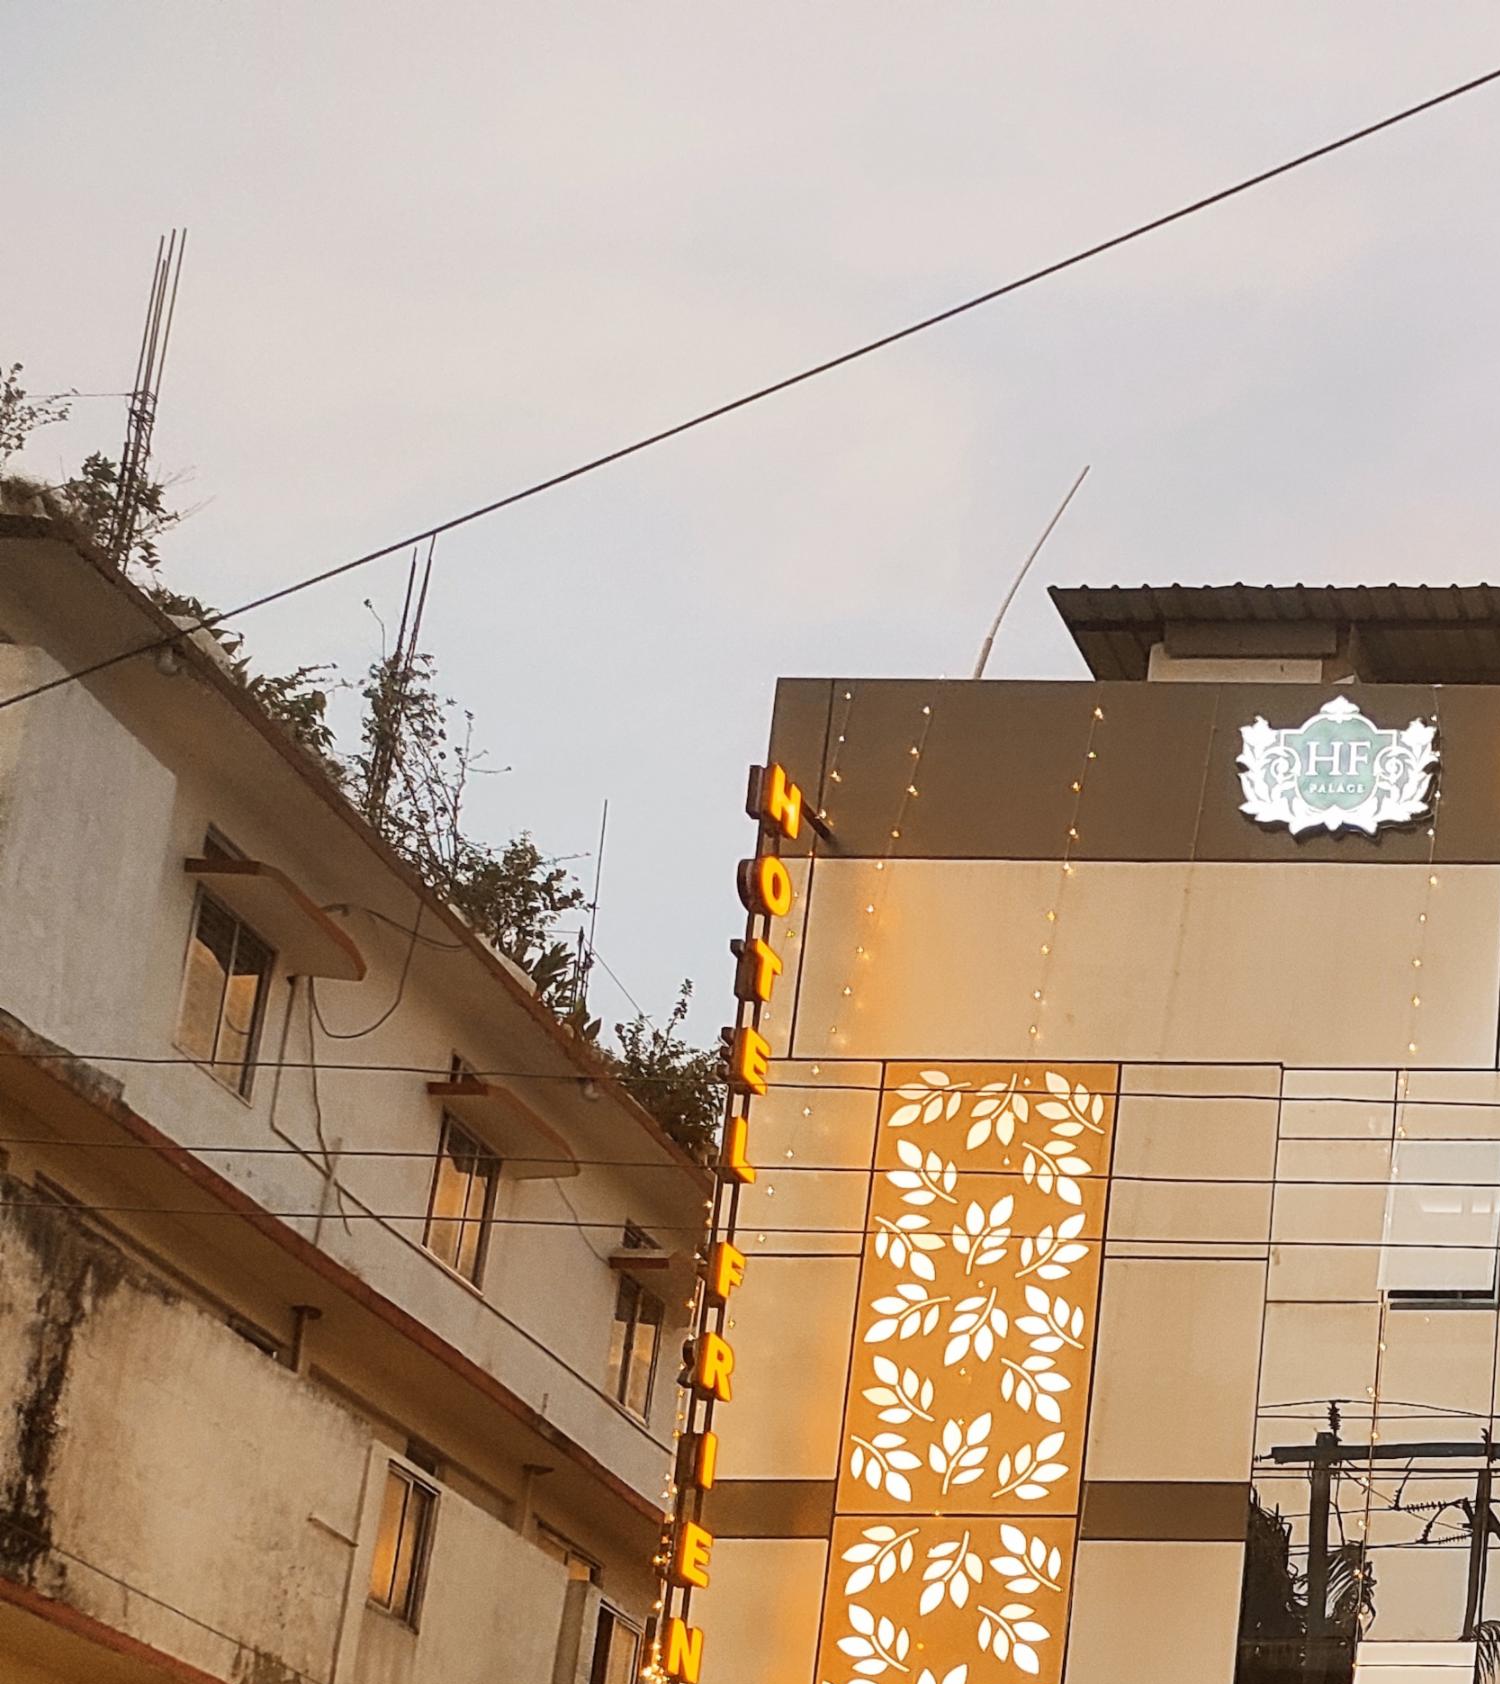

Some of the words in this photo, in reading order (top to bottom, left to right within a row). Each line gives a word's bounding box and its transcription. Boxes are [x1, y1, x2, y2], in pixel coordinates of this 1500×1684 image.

[1305, 741, 1371, 776] HF
[1309, 783, 1364, 794] PALACE
[727, 762, 801, 1184] HOTEL
